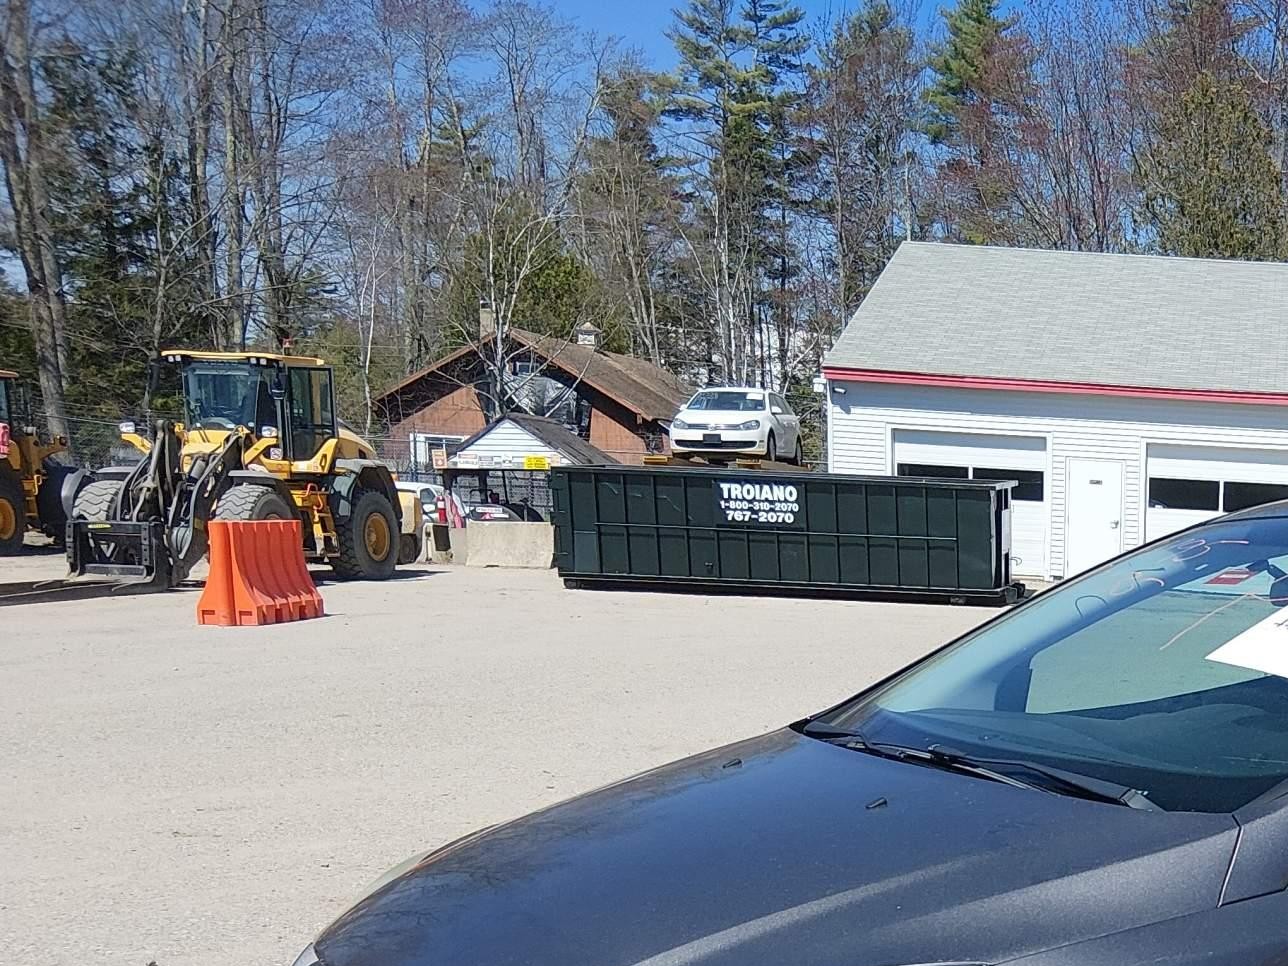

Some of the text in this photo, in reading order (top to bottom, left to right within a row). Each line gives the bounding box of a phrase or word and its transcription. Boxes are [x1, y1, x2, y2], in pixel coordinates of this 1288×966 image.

[719, 482, 798, 502] TROIANO
[719, 500, 799, 512] 1-800-310-2070
[725, 510, 795, 524] 767-2070
